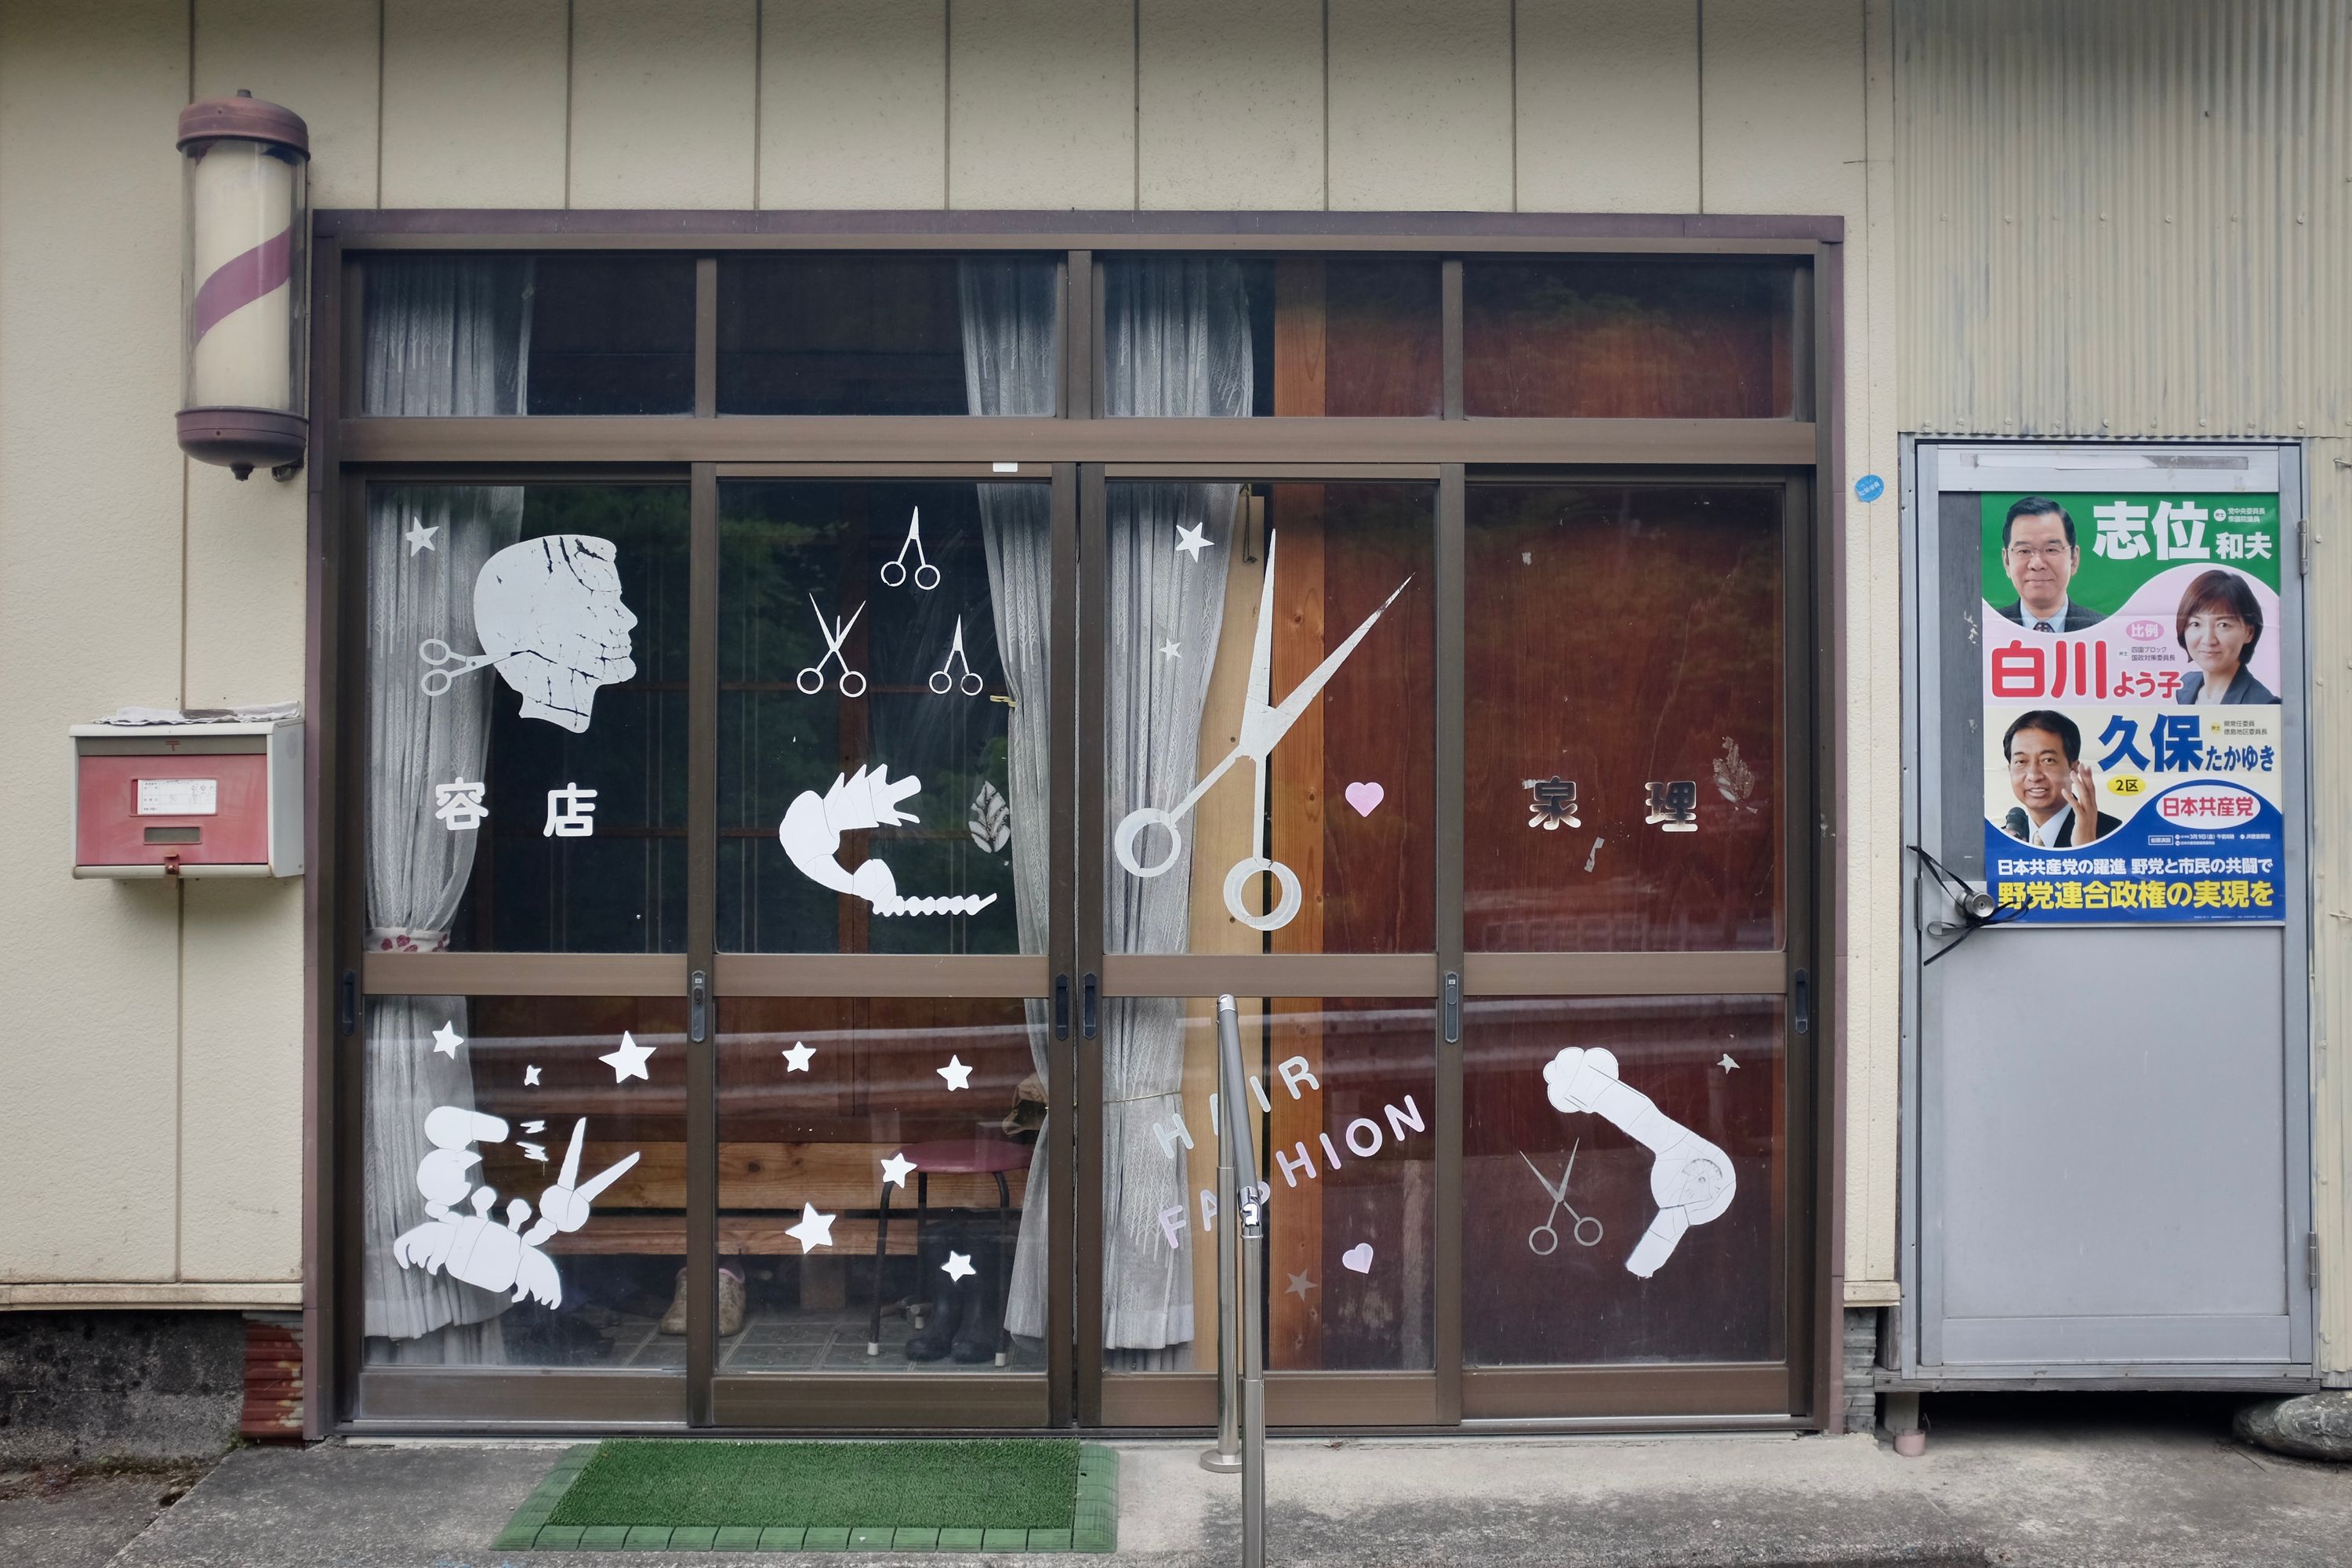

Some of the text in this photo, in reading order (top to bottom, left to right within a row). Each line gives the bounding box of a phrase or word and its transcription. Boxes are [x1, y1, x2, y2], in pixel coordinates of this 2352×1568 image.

[2092, 500, 2272, 561] 志位 和夫
[2131, 623, 2159, 637] 比例
[1991, 640, 2182, 699] 白川 よう子
[2097, 713, 2274, 772] 久保 たかゆき
[2115, 779, 2139, 792] 2区
[2163, 797, 2254, 817] 日本共産党
[1998, 858, 2274, 876] 日本共産党の躍進 野党と市民の共闘で
[1998, 880, 2274, 910] 野党連合政権の実現を
